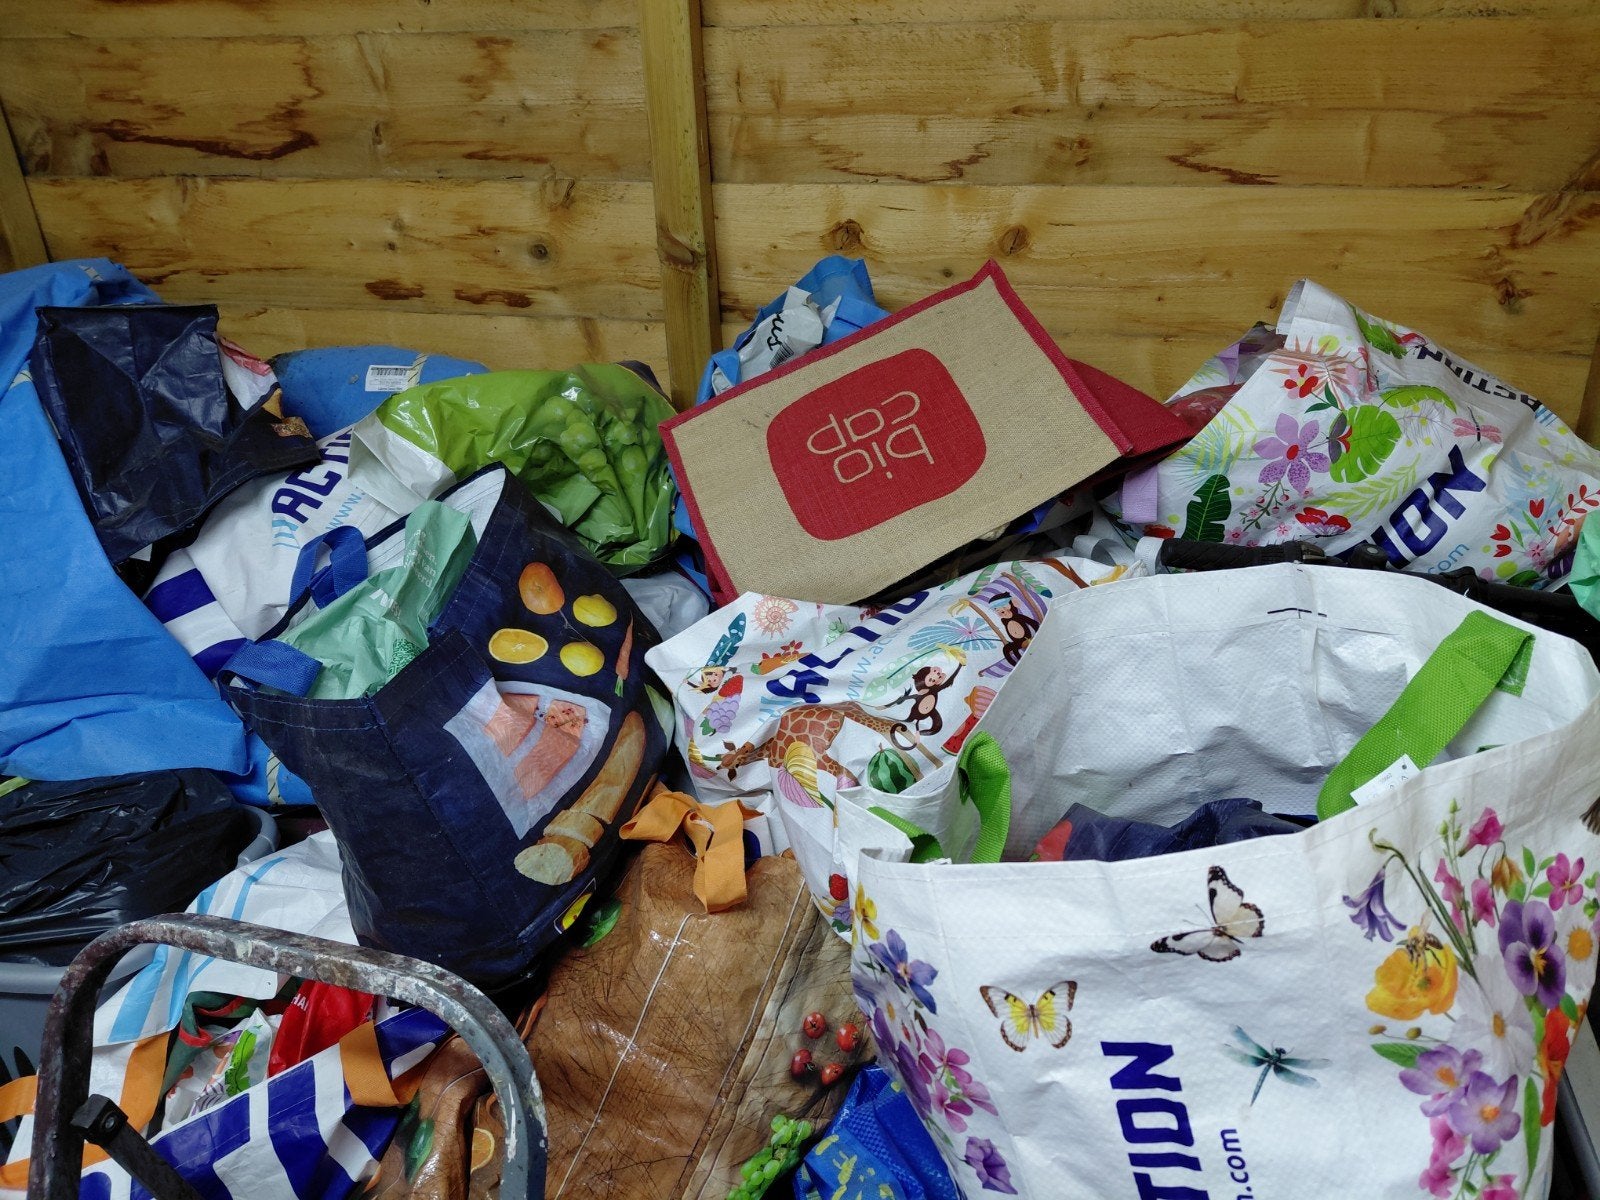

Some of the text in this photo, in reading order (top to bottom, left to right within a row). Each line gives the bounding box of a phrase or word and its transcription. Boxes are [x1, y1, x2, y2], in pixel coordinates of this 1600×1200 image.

[806, 390, 921, 455] cap
[833, 423, 935, 484] bio
[1334, 444, 1487, 570] ION
[1100, 1041, 1210, 1200] TION
